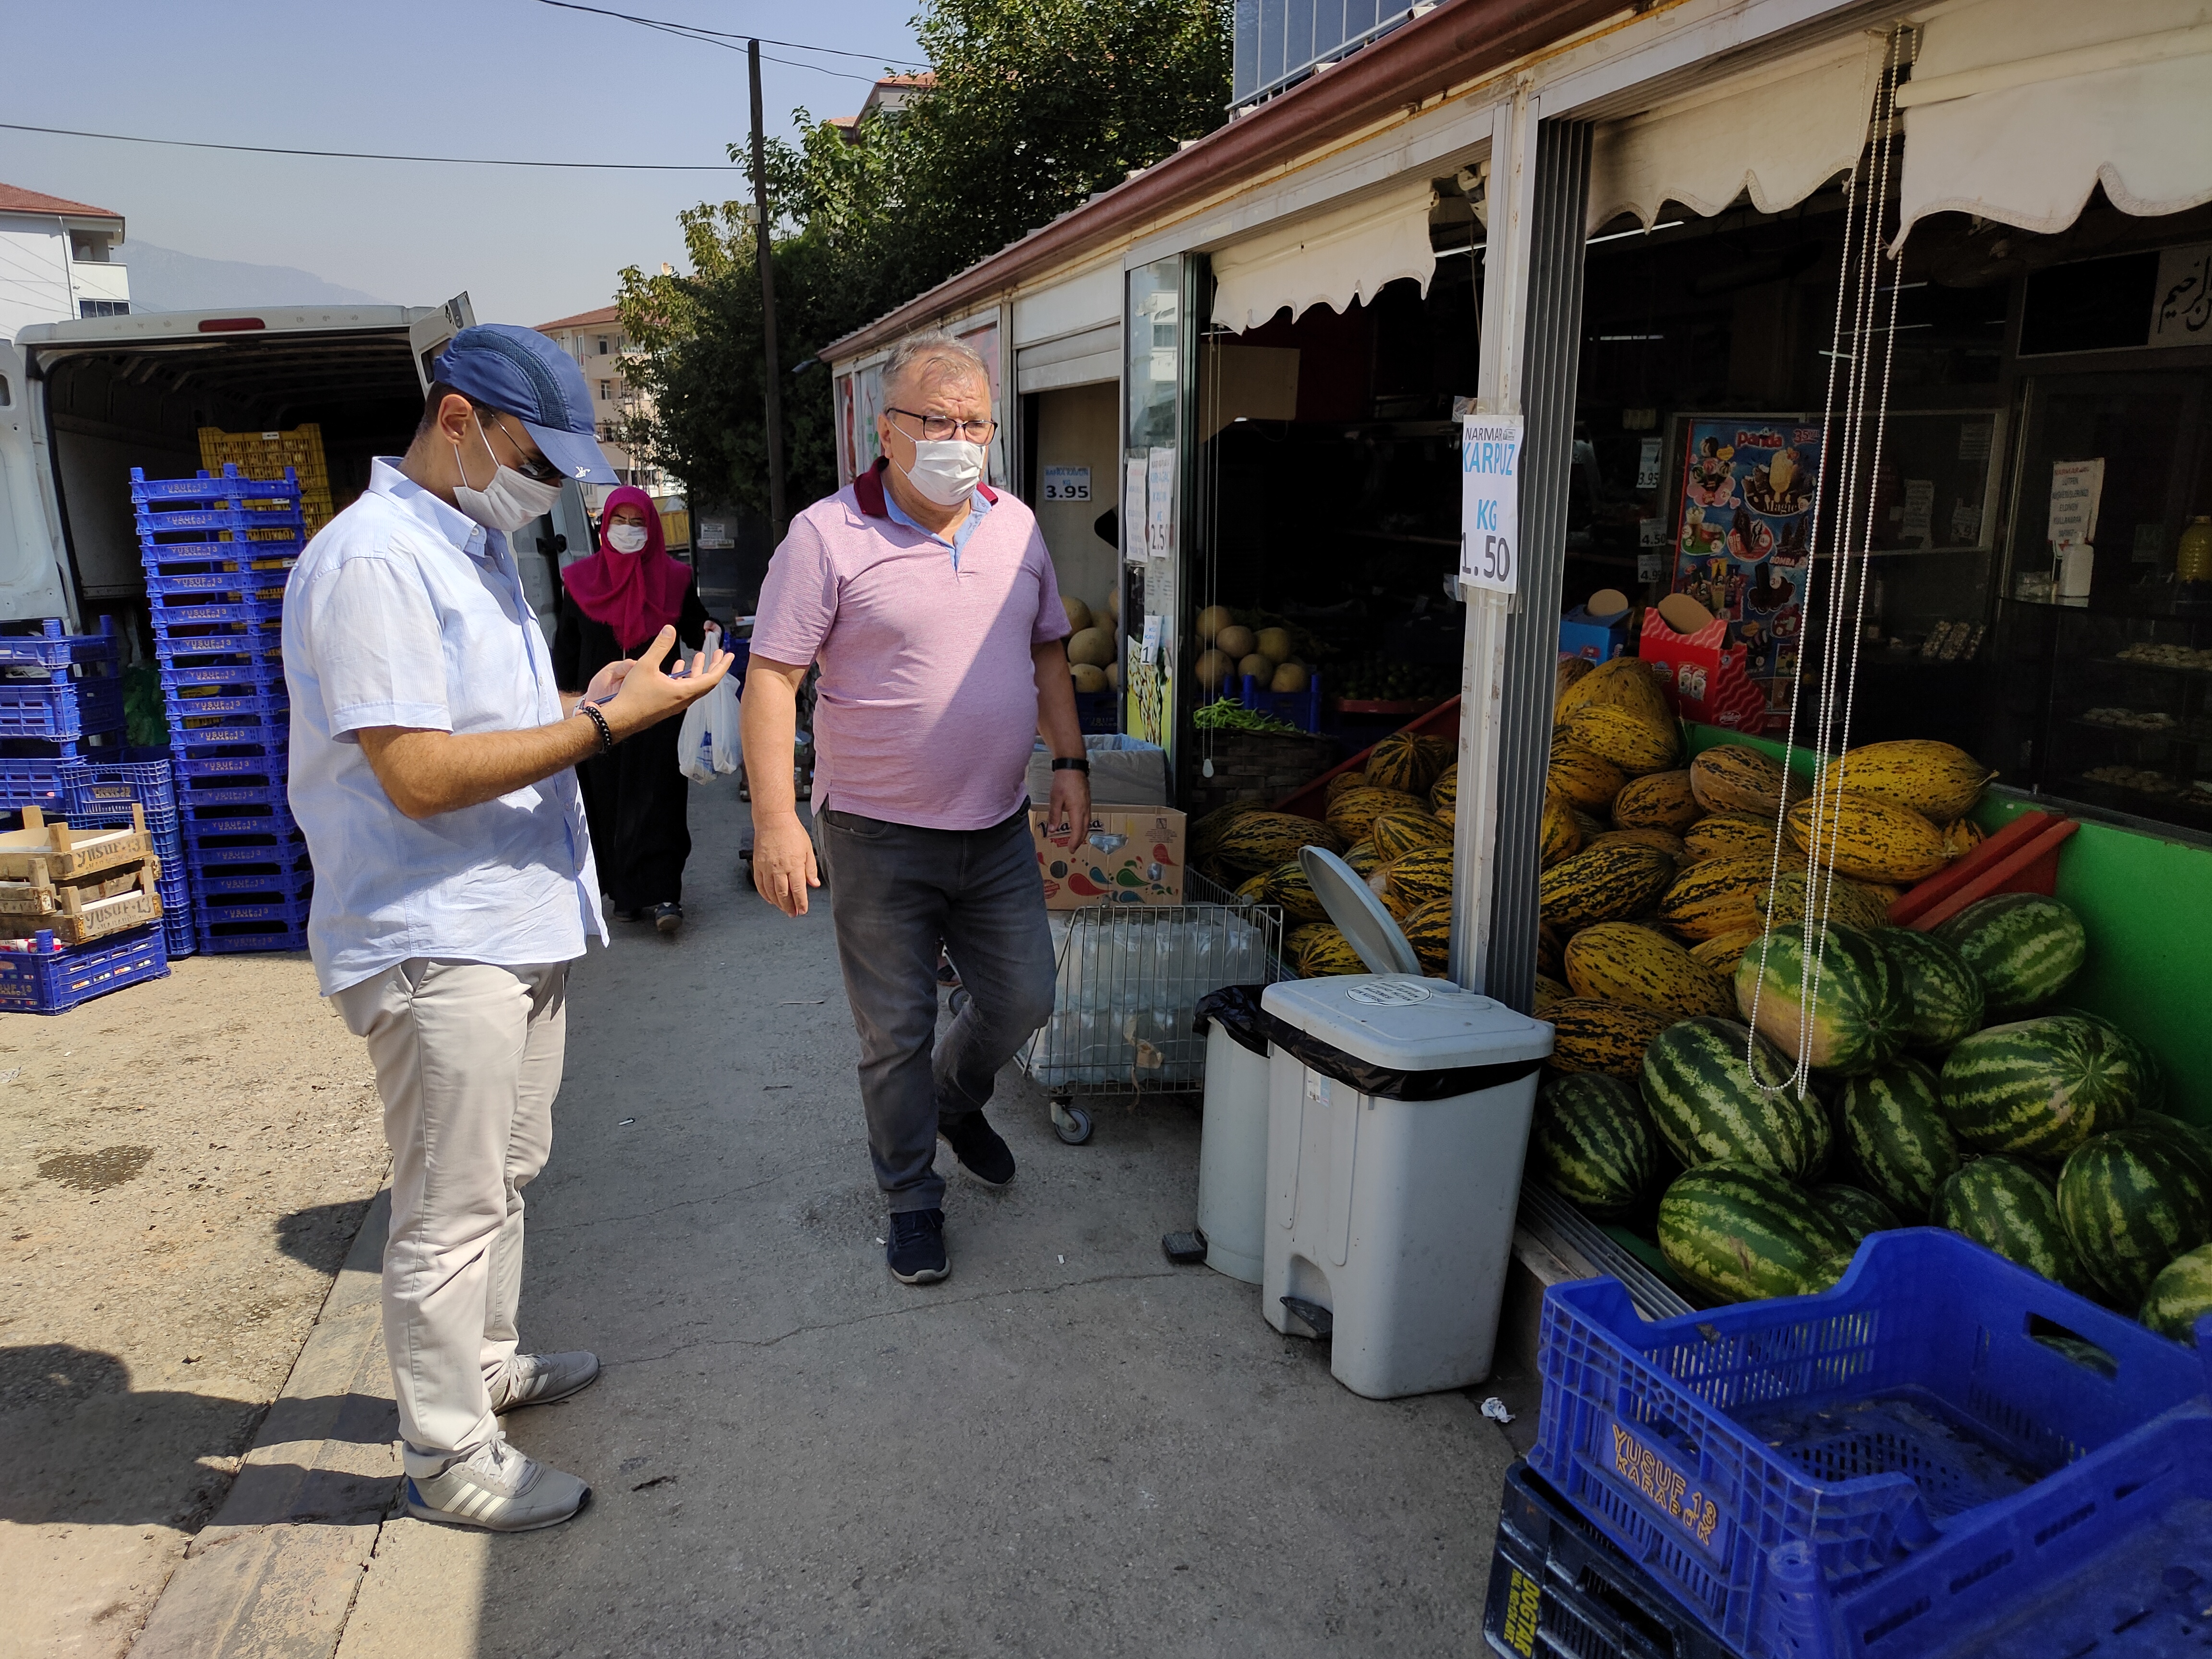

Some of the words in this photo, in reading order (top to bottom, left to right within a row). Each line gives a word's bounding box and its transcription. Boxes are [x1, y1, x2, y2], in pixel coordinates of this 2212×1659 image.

[1465, 427, 1503, 441] NARMAR
[1463, 442, 1515, 476] KARPUZ
[161, 482, 207, 491] YUSUF-13
[1046, 485, 1088, 498] 3.95
[1477, 499, 1497, 531] KG
[1764, 500, 1798, 515] Magic
[1151, 523, 1168, 551] 2.5
[1642, 534, 1666, 545] 4.50
[1729, 533, 1741, 544] BIG
[1462, 532, 1510, 582] 1.50
[1769, 556, 1795, 567] BOMBA
[85, 901, 131, 930] YUSUF
[137, 894, 152, 914] 13
[21, 985, 33, 993] 13
[1612, 1424, 1686, 1499] YUSUF
[1692, 1491, 1717, 1530] 13
[1514, 1576, 1540, 1659] DOGTAR
